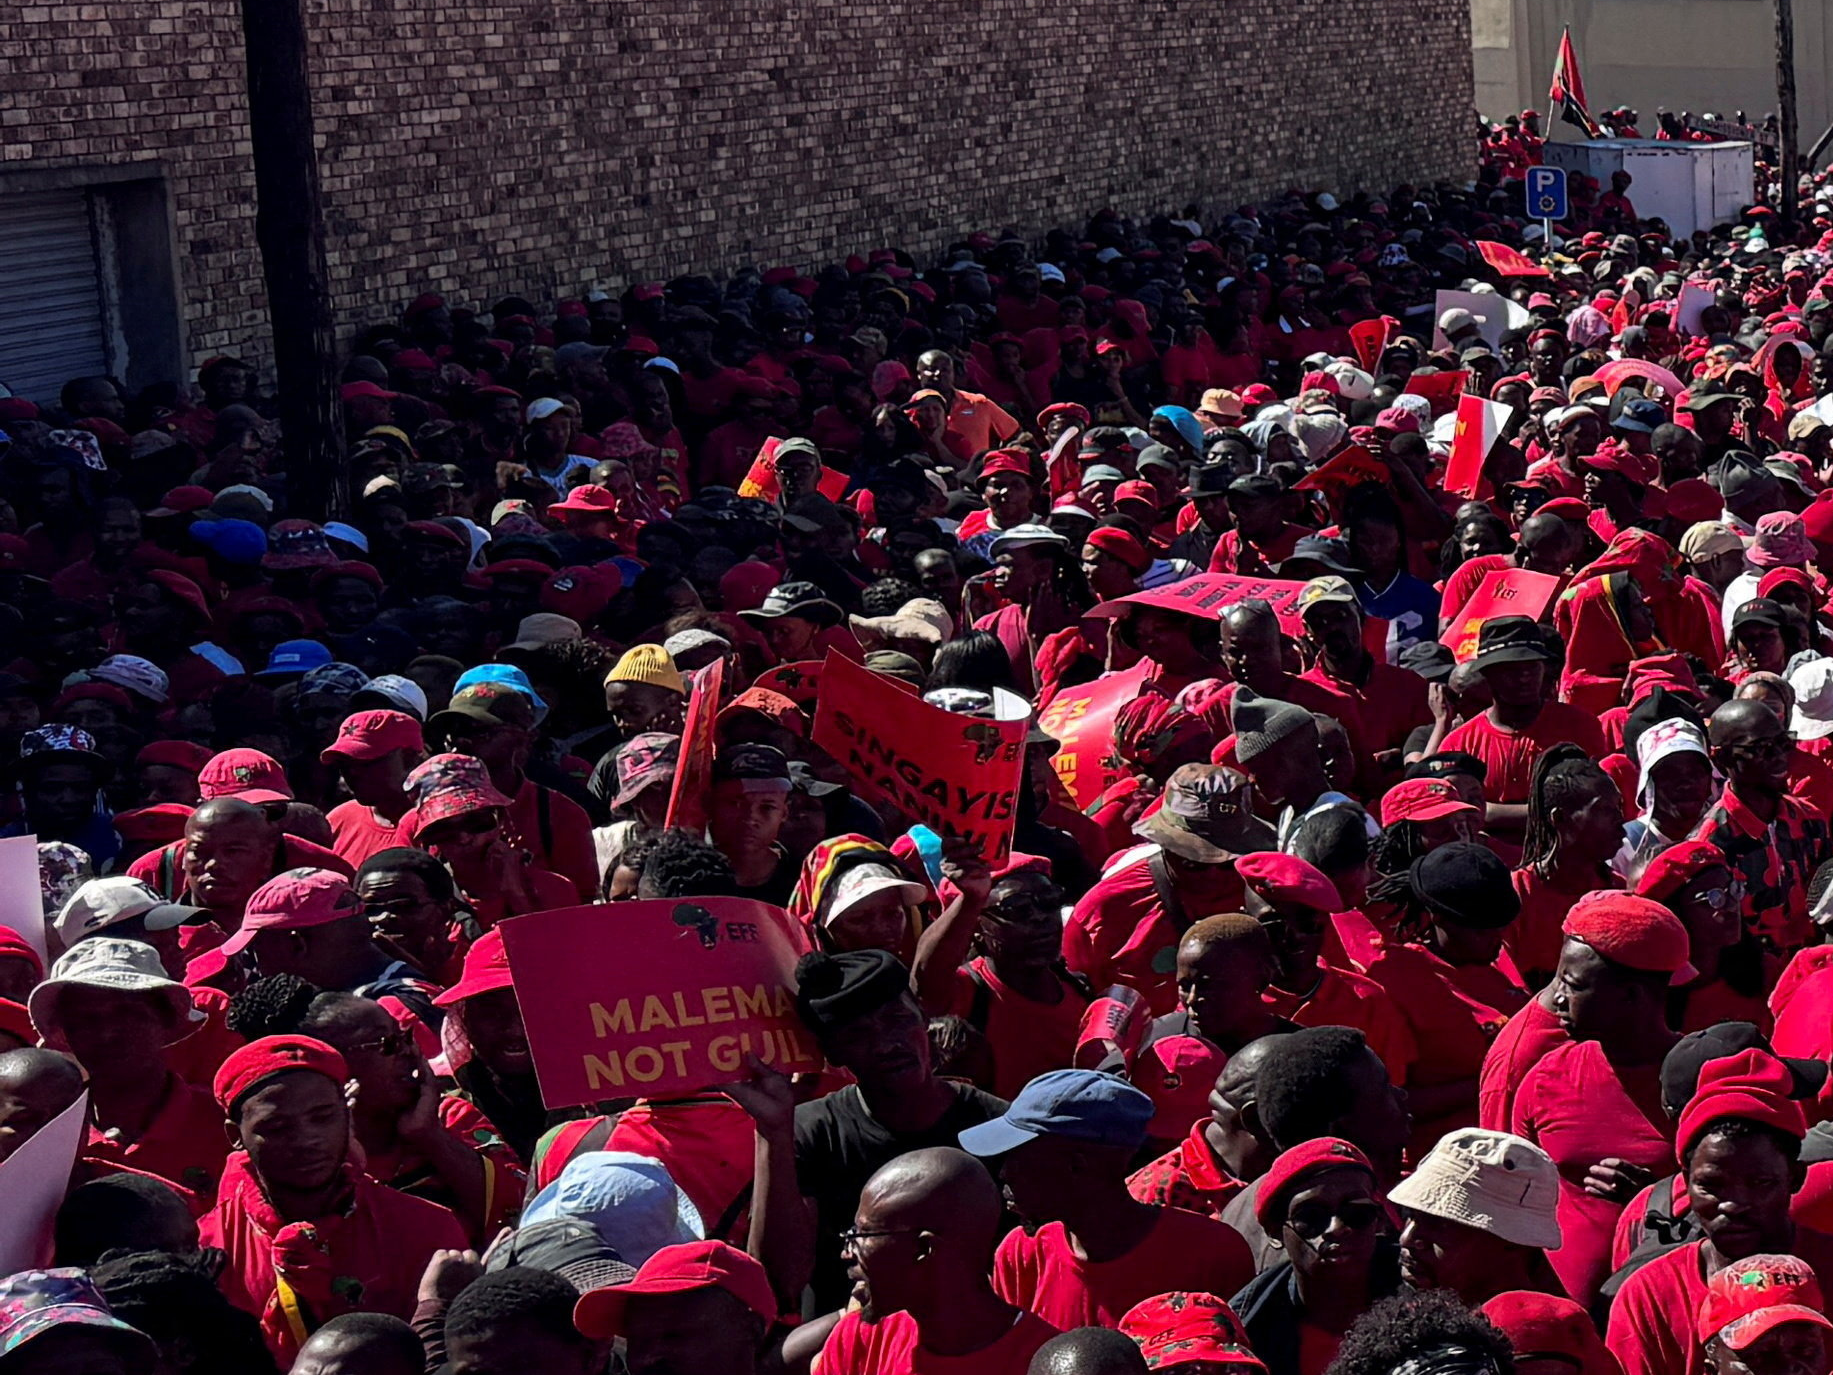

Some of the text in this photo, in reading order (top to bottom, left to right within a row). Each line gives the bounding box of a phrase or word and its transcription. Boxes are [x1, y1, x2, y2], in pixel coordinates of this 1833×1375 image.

[1536, 171, 1555, 192] P
[727, 922, 759, 943] EFF
[588, 983, 797, 1038] MALEMA
[582, 1040, 692, 1090] NOT
[1773, 1271, 1808, 1287] EFF
